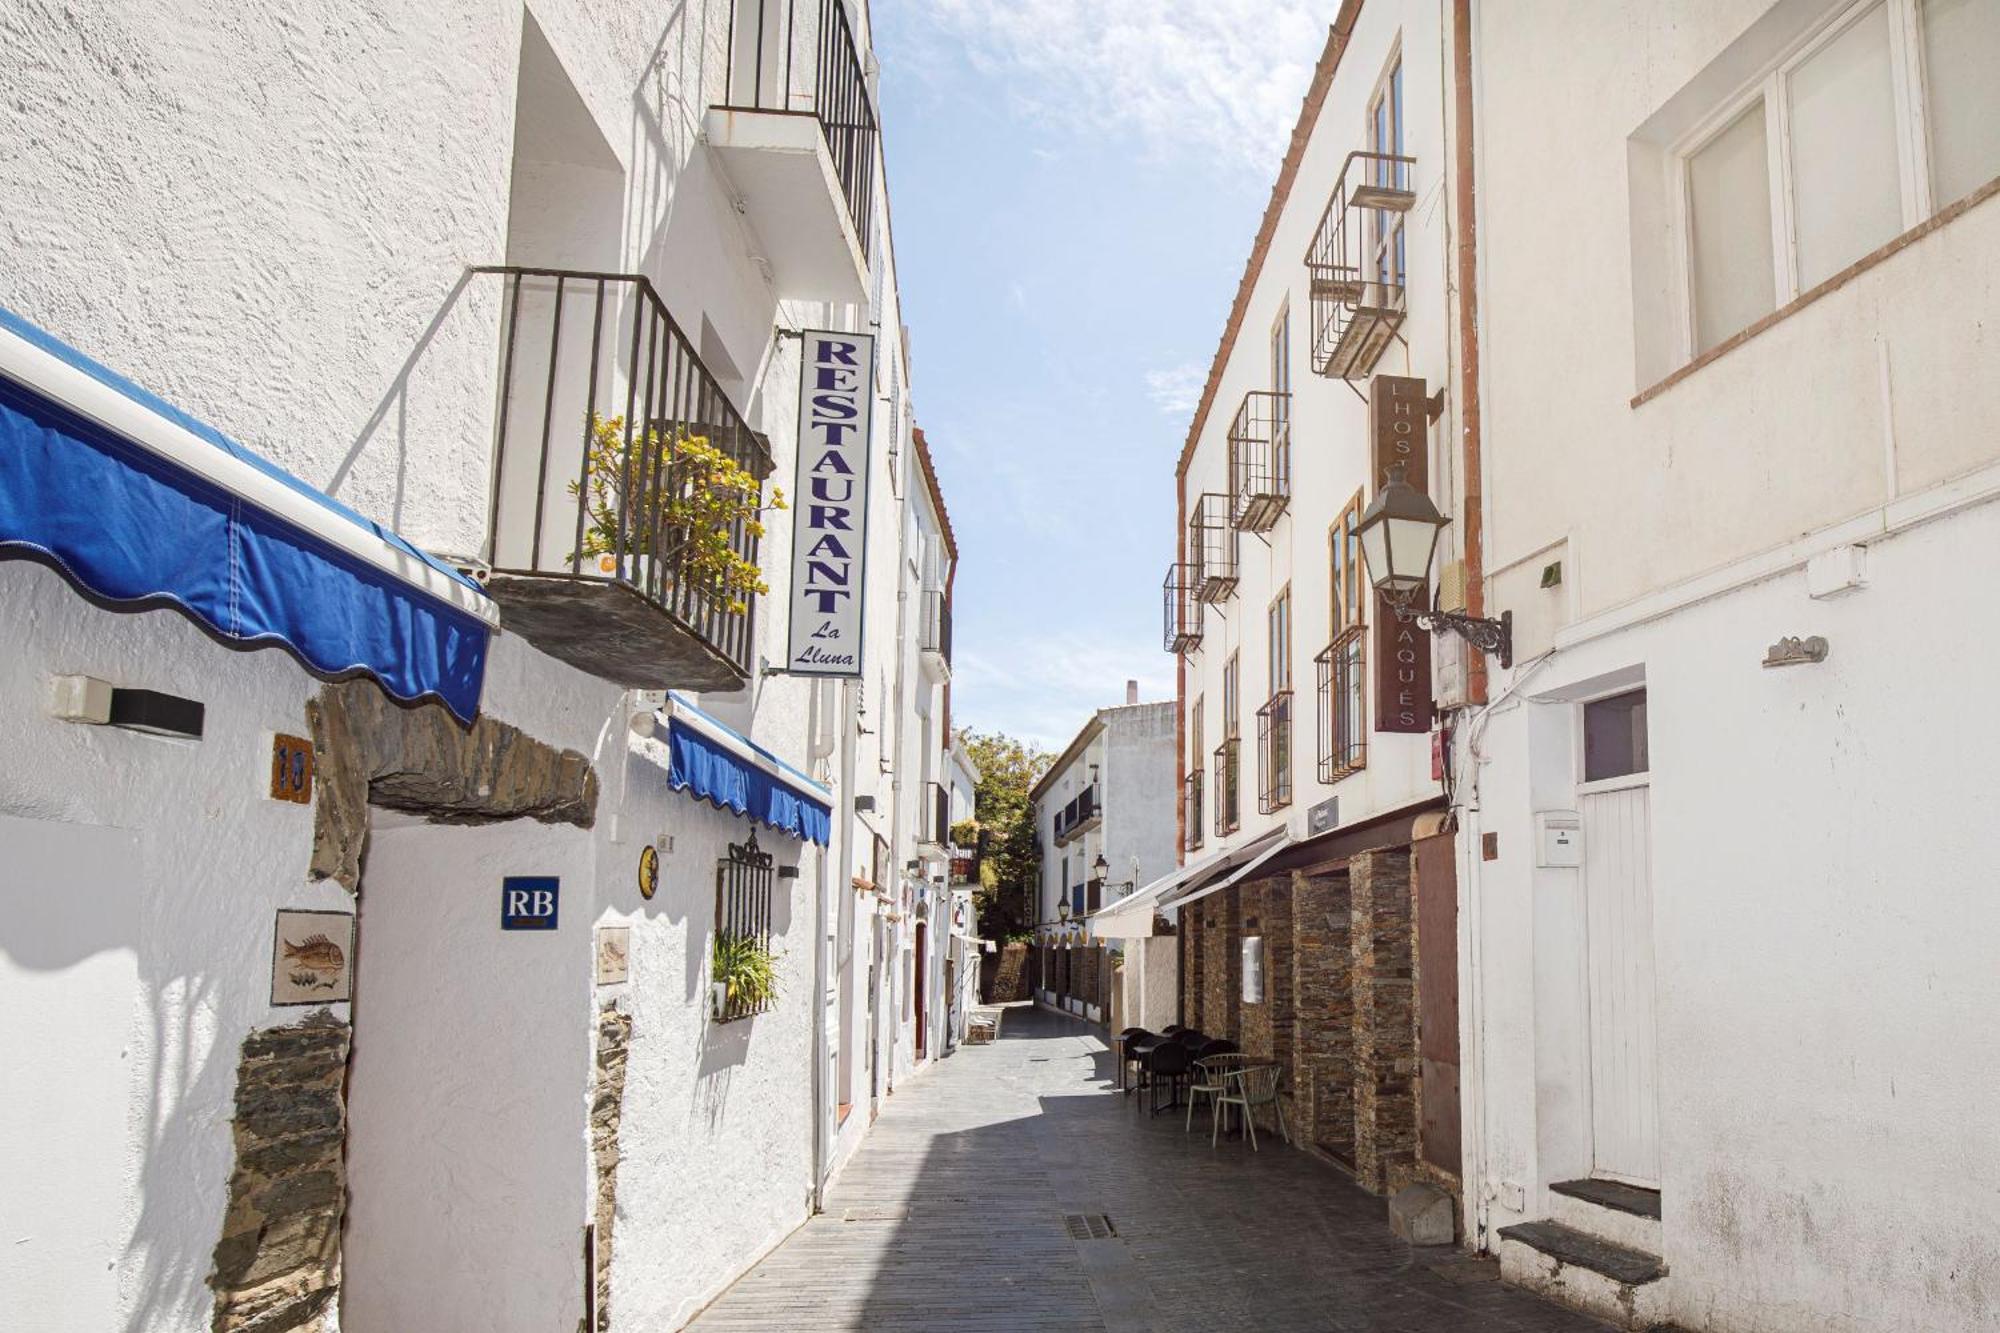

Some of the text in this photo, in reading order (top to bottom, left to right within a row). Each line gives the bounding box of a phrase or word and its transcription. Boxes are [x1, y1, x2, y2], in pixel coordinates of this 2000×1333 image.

[804, 339, 859, 614] RESTAURANT
[811, 620, 841, 639] La
[794, 645, 854, 666] Lluna
[507, 889, 554, 917] RB
